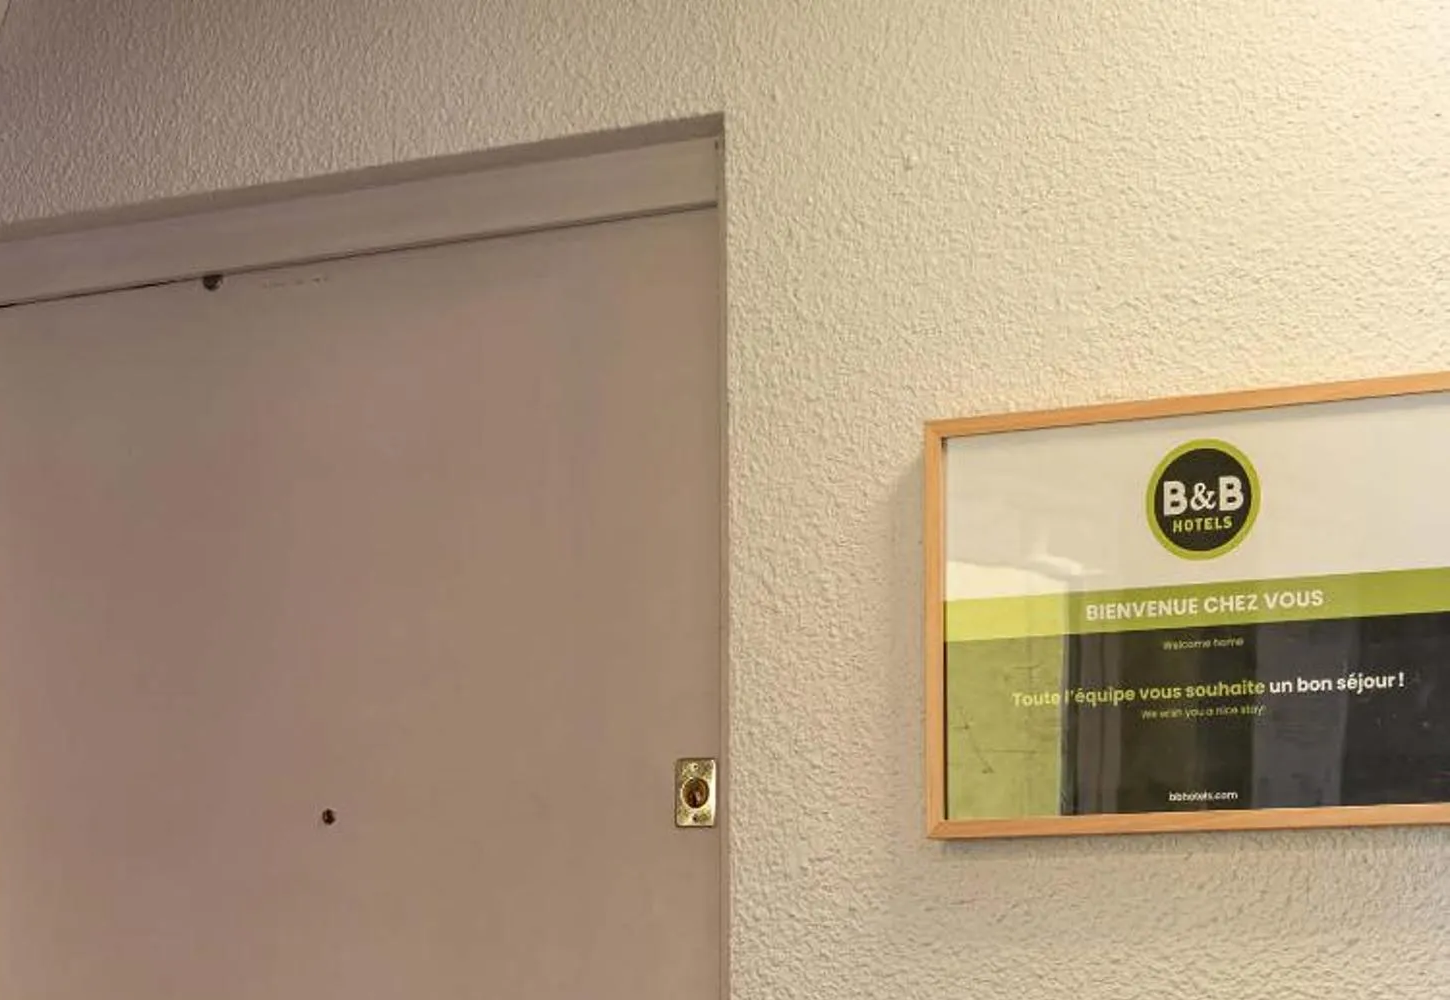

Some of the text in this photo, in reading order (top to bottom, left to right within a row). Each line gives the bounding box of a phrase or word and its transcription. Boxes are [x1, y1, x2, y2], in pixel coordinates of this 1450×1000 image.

[1163, 475, 1245, 517] B&B
[1172, 515, 1234, 534] HOTELS
[1085, 589, 1325, 621] BIENVENUE CHEZ VOUS
[1012, 690, 1060, 708] Toute
[1064, 686, 1136, 708] l'équipe
[1139, 685, 1183, 700] vous
[1185, 679, 1266, 698] souhaite
[1269, 679, 1293, 694] un
[1296, 676, 1332, 693] bon
[1336, 671, 1397, 695] séjour
[1168, 789, 1239, 803] bbhotels.com
